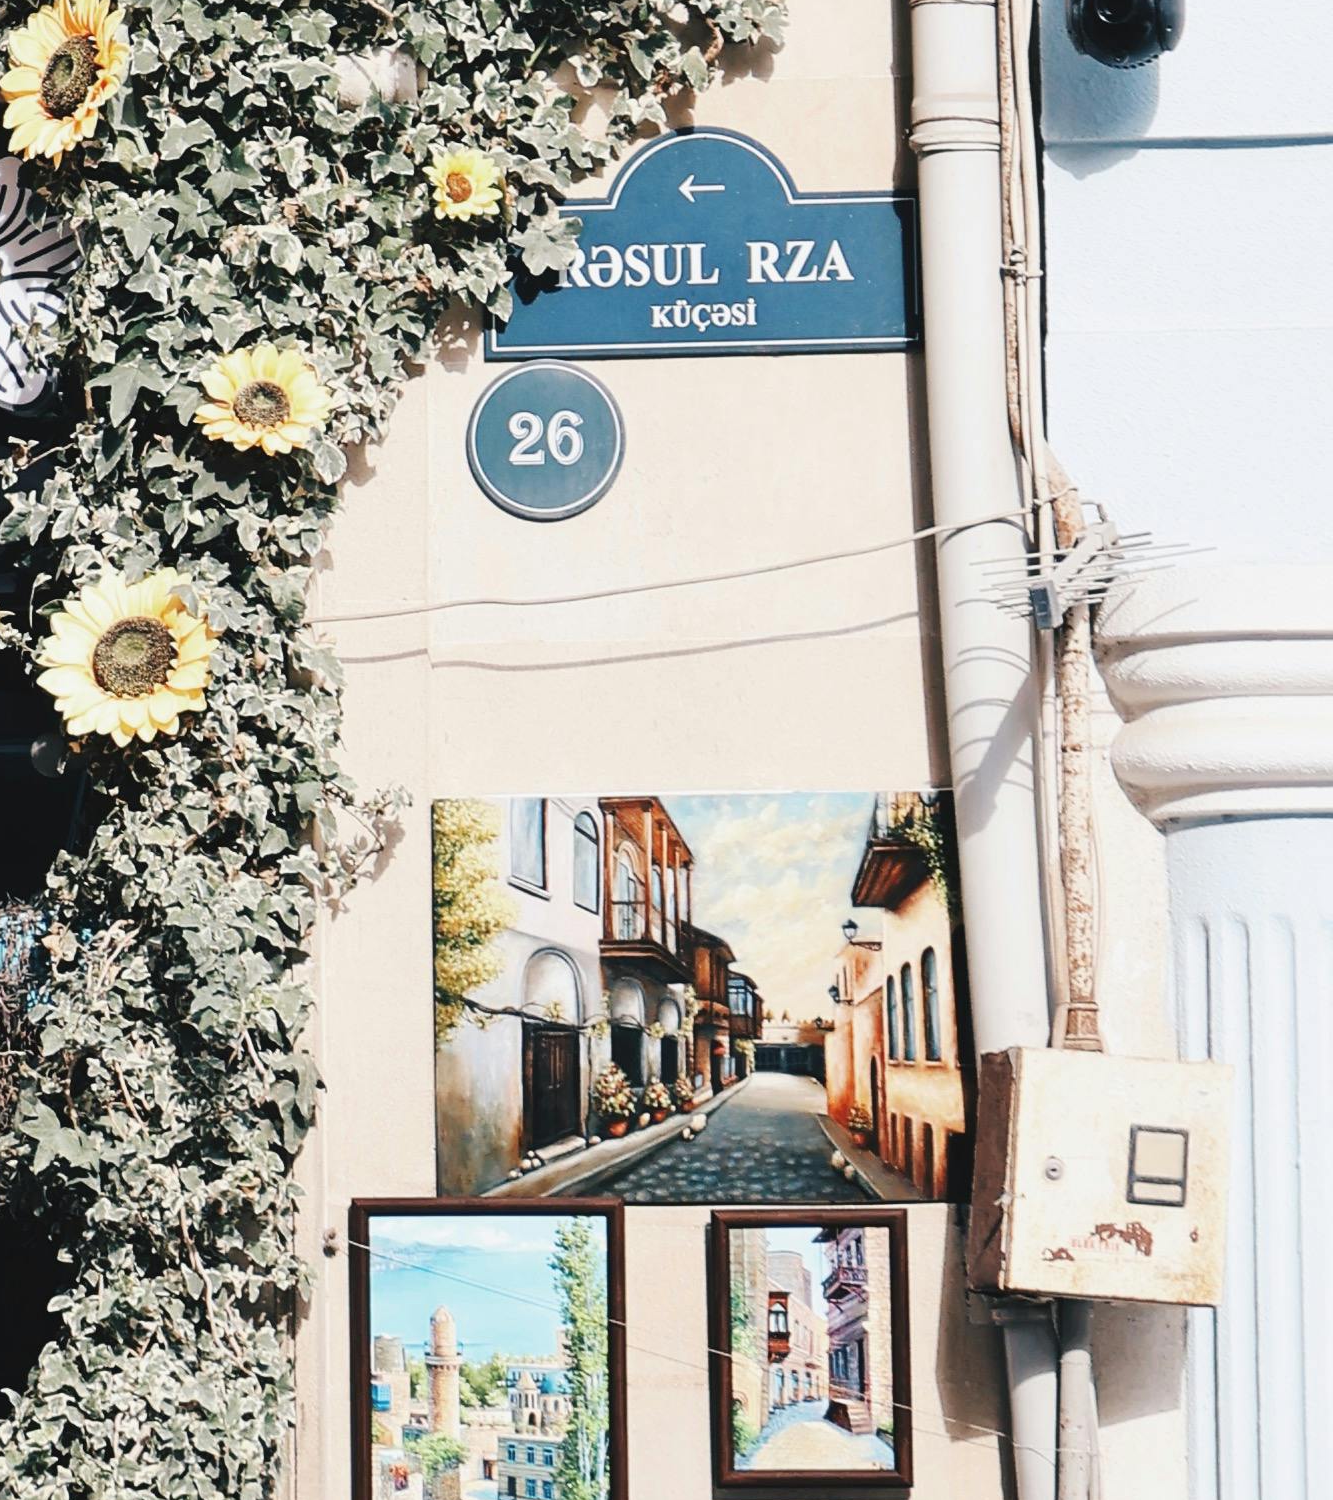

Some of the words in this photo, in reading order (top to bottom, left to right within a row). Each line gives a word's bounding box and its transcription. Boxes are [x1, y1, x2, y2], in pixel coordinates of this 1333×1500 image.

[556, 242, 720, 289] RƏSUL
[746, 239, 854, 284] RZA
[650, 297, 758, 332] KÜÇƏSİ
[508, 410, 584, 466] 26
